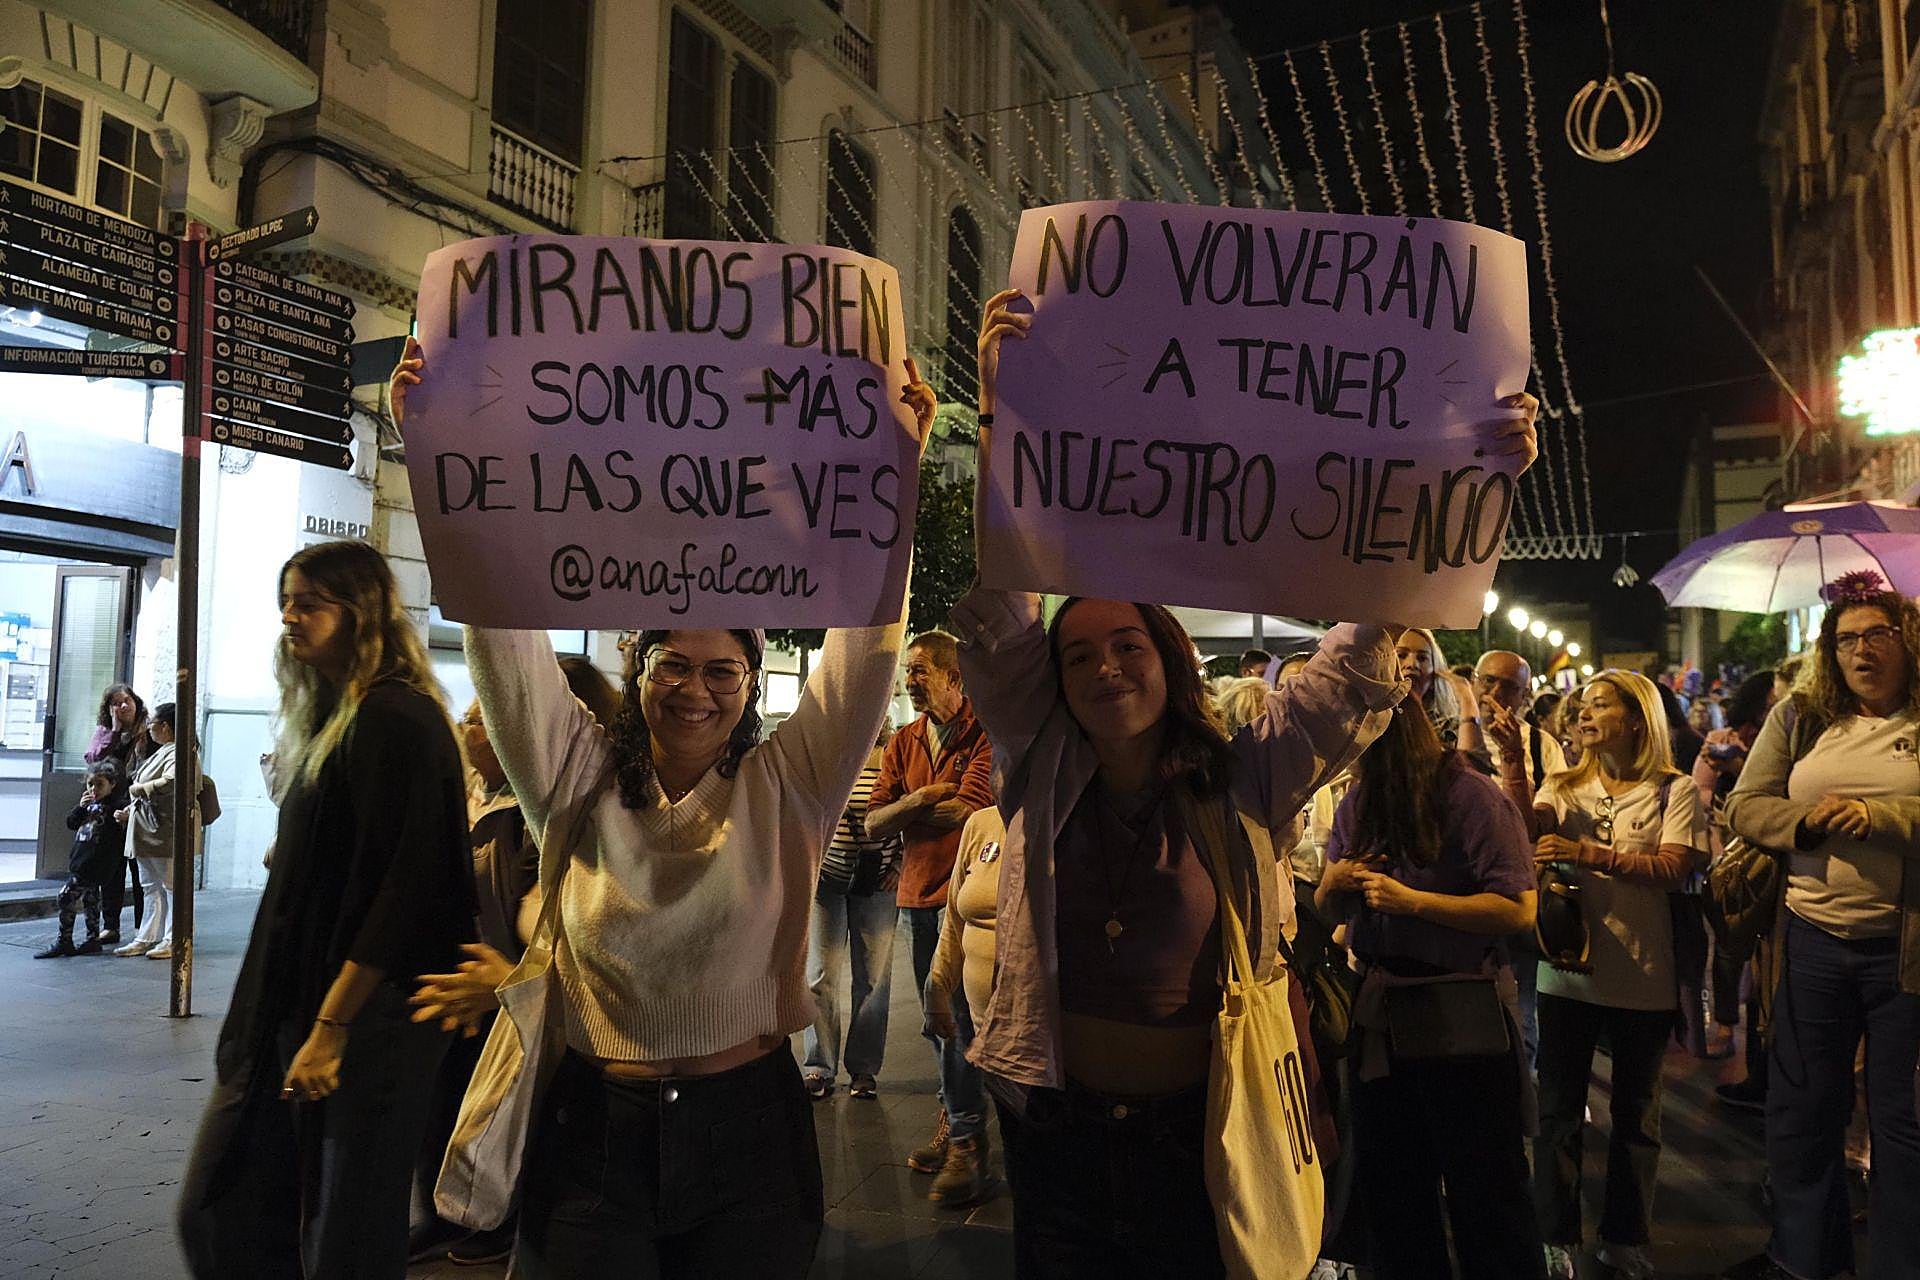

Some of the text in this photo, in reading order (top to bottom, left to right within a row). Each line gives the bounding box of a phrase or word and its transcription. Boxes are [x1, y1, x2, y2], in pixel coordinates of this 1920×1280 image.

[31, 193, 155, 245] HURTADO DE MENDOZA
[221, 218, 284, 249] RECTORADO ULPGC
[41, 227, 80, 250] PLAZA
[84, 240, 98, 255] DE
[101, 246, 155, 273] CAIRASCO
[42, 258, 98, 286] ALAMEDA
[102, 276, 116, 291] DE
[119, 280, 154, 301] COLÓN
[235, 262, 280, 287] CATEDRAL
[282, 278, 294, 291] DE
[295, 282, 323, 301] SANTA
[325, 291, 342, 308] ANA
[1036, 213, 1478, 334] NO VOLVERÁN
[11, 282, 152, 330] CALLE MAYOR DE TRIANA
[235, 289, 266, 309] PLAZA
[268, 300, 280, 313] DE
[282, 303, 311, 322] SANTA
[313, 313, 332, 329] ANA
[781, 252, 891, 367] BIEN
[4, 349, 146, 368] INFORMACIÓN TURÍSTICA
[233, 343, 258, 360] ARTE
[260, 349, 290, 368] SACRO
[234, 316, 337, 356] CASAS CONSISTORIALES
[232, 397, 261, 414] CAAM
[233, 370, 303, 398] CASA DE COLÓN
[526, 360, 730, 431] SOMOS
[1142, 337, 1410, 430] A TENER
[232, 424, 304, 451] MUSEO CANARIO
[435, 450, 901, 550] DE LAS QUE VES
[1013, 430, 1514, 575] NUESTRO SILENCIO
[306, 514, 369, 538] OBISPO
[550, 543, 819, 615] @anafalconn
